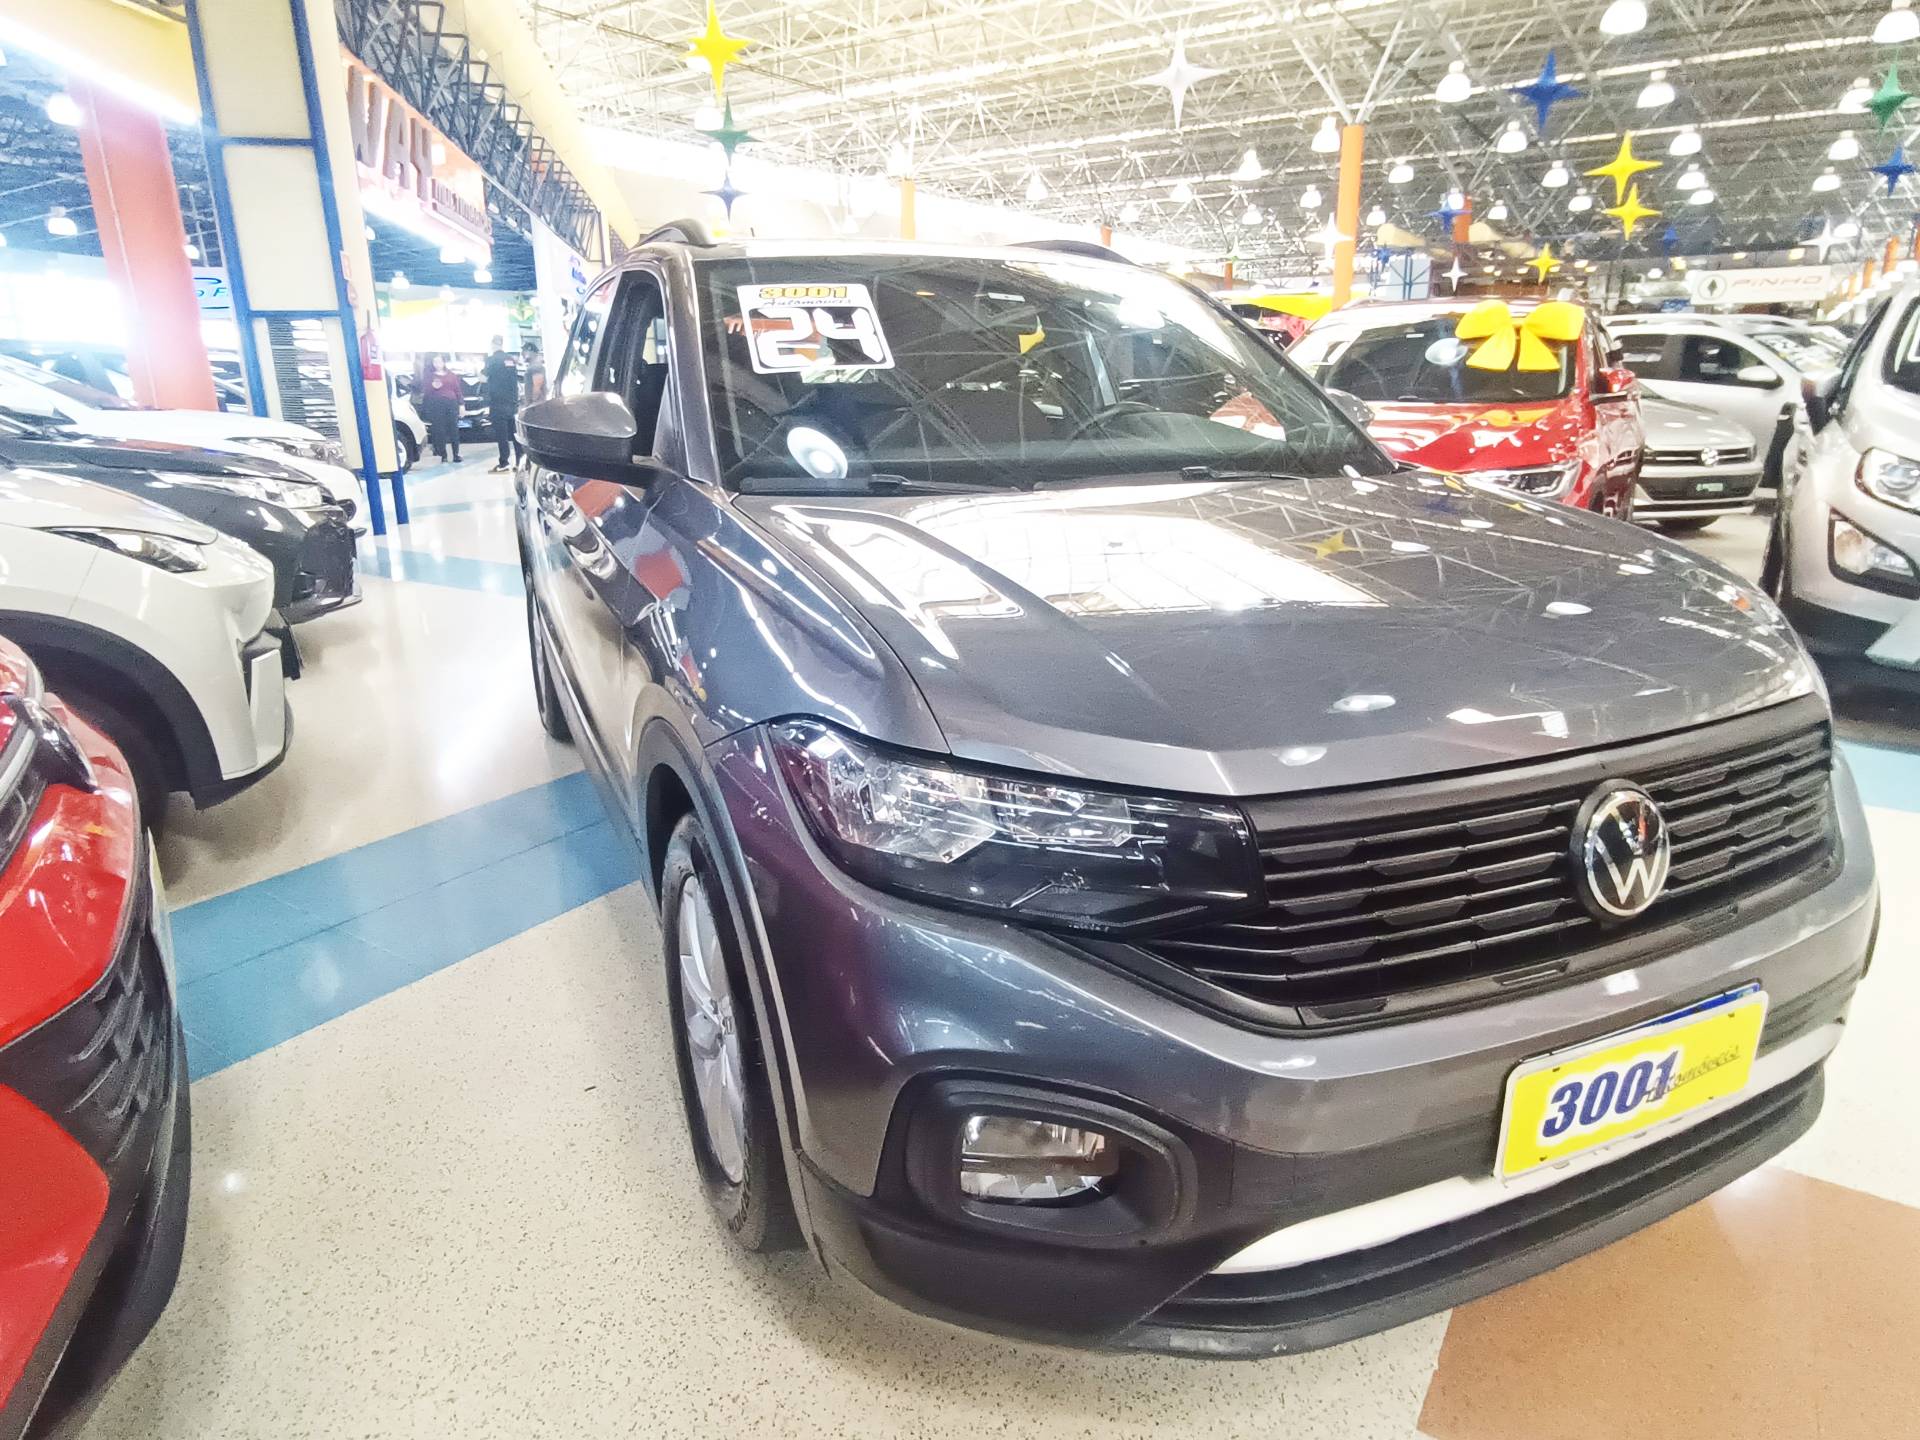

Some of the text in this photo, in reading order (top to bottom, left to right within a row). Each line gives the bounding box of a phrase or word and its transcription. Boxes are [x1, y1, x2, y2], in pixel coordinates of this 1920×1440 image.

[759, 286, 847, 299] 3001
[756, 307, 884, 368] 24
[1542, 1050, 1678, 1138] 3001
